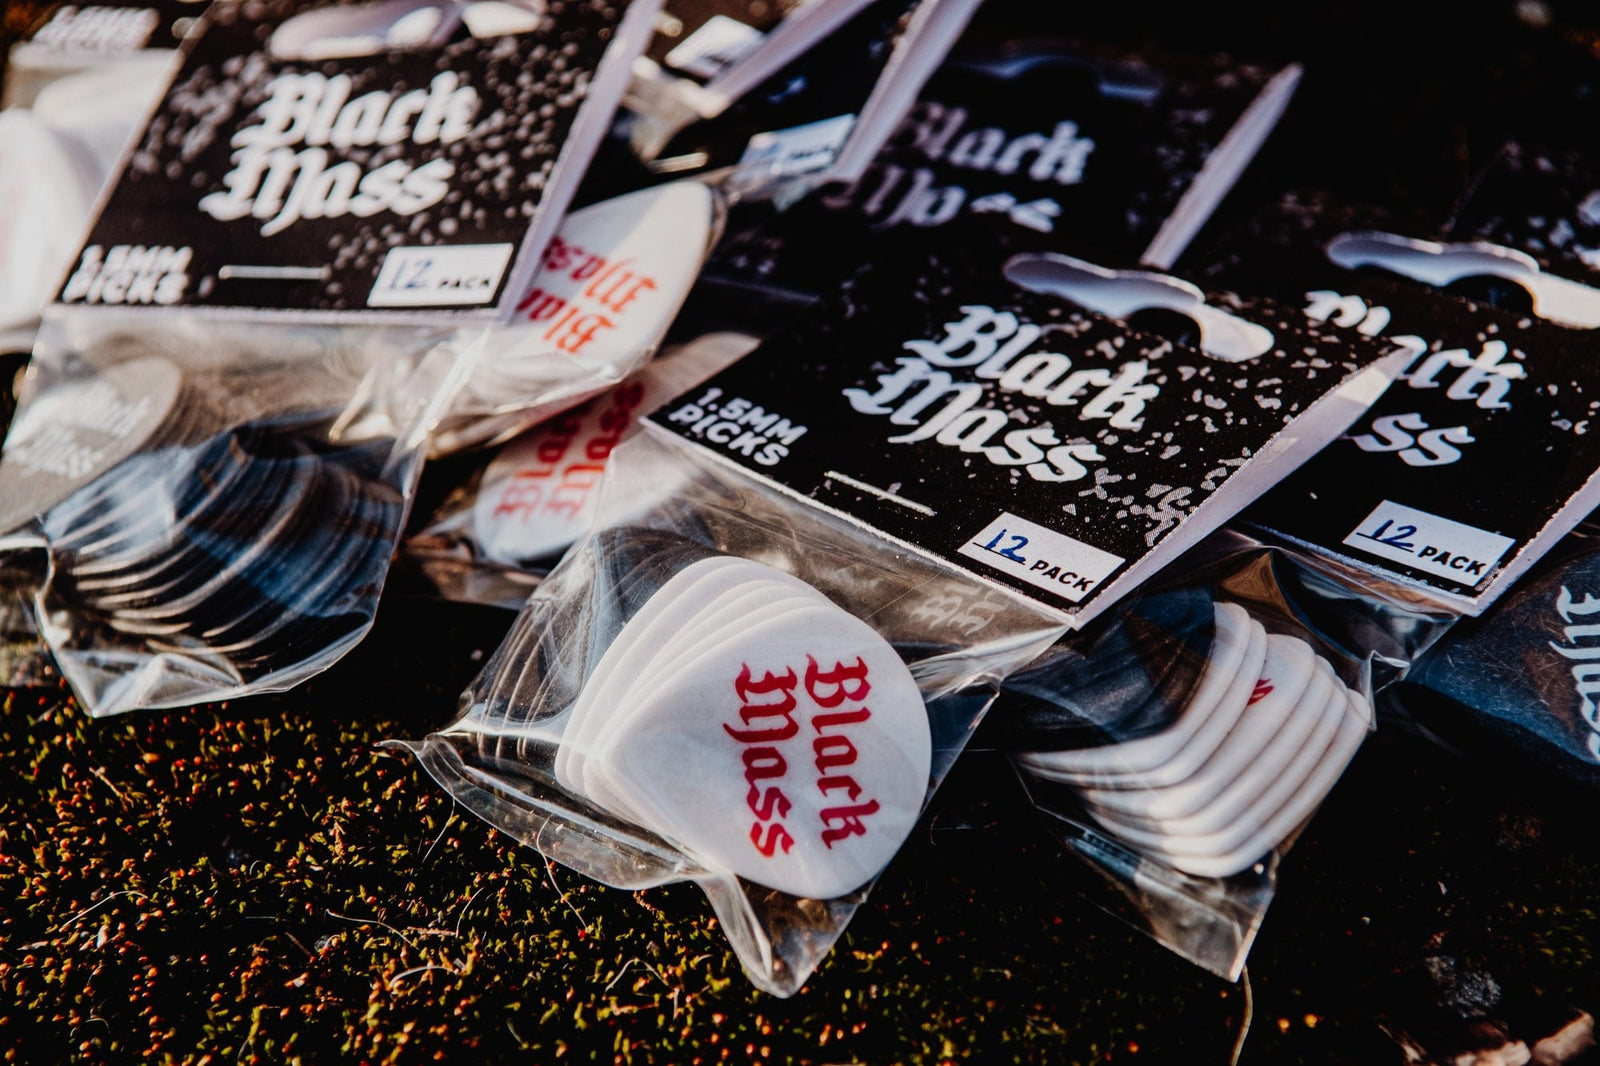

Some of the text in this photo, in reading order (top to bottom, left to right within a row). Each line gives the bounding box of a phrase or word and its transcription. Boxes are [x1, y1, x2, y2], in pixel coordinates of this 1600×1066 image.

[230, 70, 477, 148] Black
[198, 146, 455, 237] Mass
[903, 305, 1160, 431] Black
[668, 403, 790, 466] PICKS
[697, 387, 808, 446] 1.5MM
[842, 357, 1106, 482] Mass
[984, 528, 1095, 592] 12 PACK
[1370, 519, 1487, 576] 12 PACK
[722, 661, 800, 858] Mass
[804, 653, 880, 850] Black
